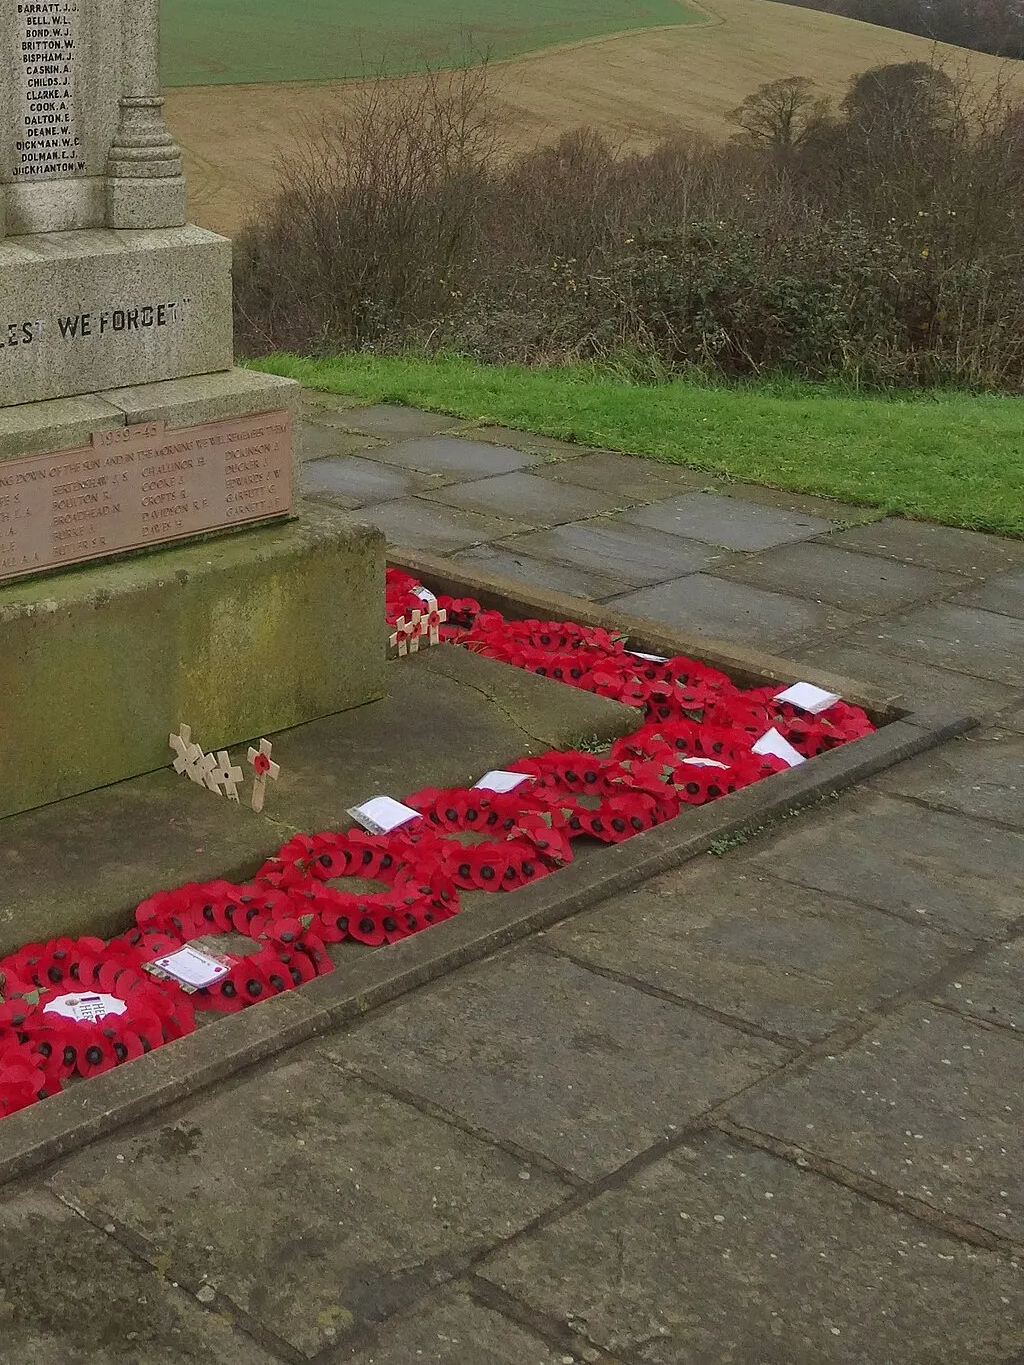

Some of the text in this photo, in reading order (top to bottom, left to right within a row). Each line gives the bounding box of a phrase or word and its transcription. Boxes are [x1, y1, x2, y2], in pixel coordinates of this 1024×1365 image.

[58, 313, 91, 339] WE
[15, 468, 46, 484] DOWN
[63, 461, 81, 475] THE
[82, 457, 101, 471] SUN
[104, 454, 123, 467] AND
[136, 448, 152, 460] THE
[152, 440, 193, 457] MORNING
[208, 433, 225, 447] WILL
[226, 426, 264, 443] REMEMBER
[141, 475, 175, 492] COOKE
[141, 490, 175, 507] CROFTS
[141, 501, 188, 522] DAVIDSON
